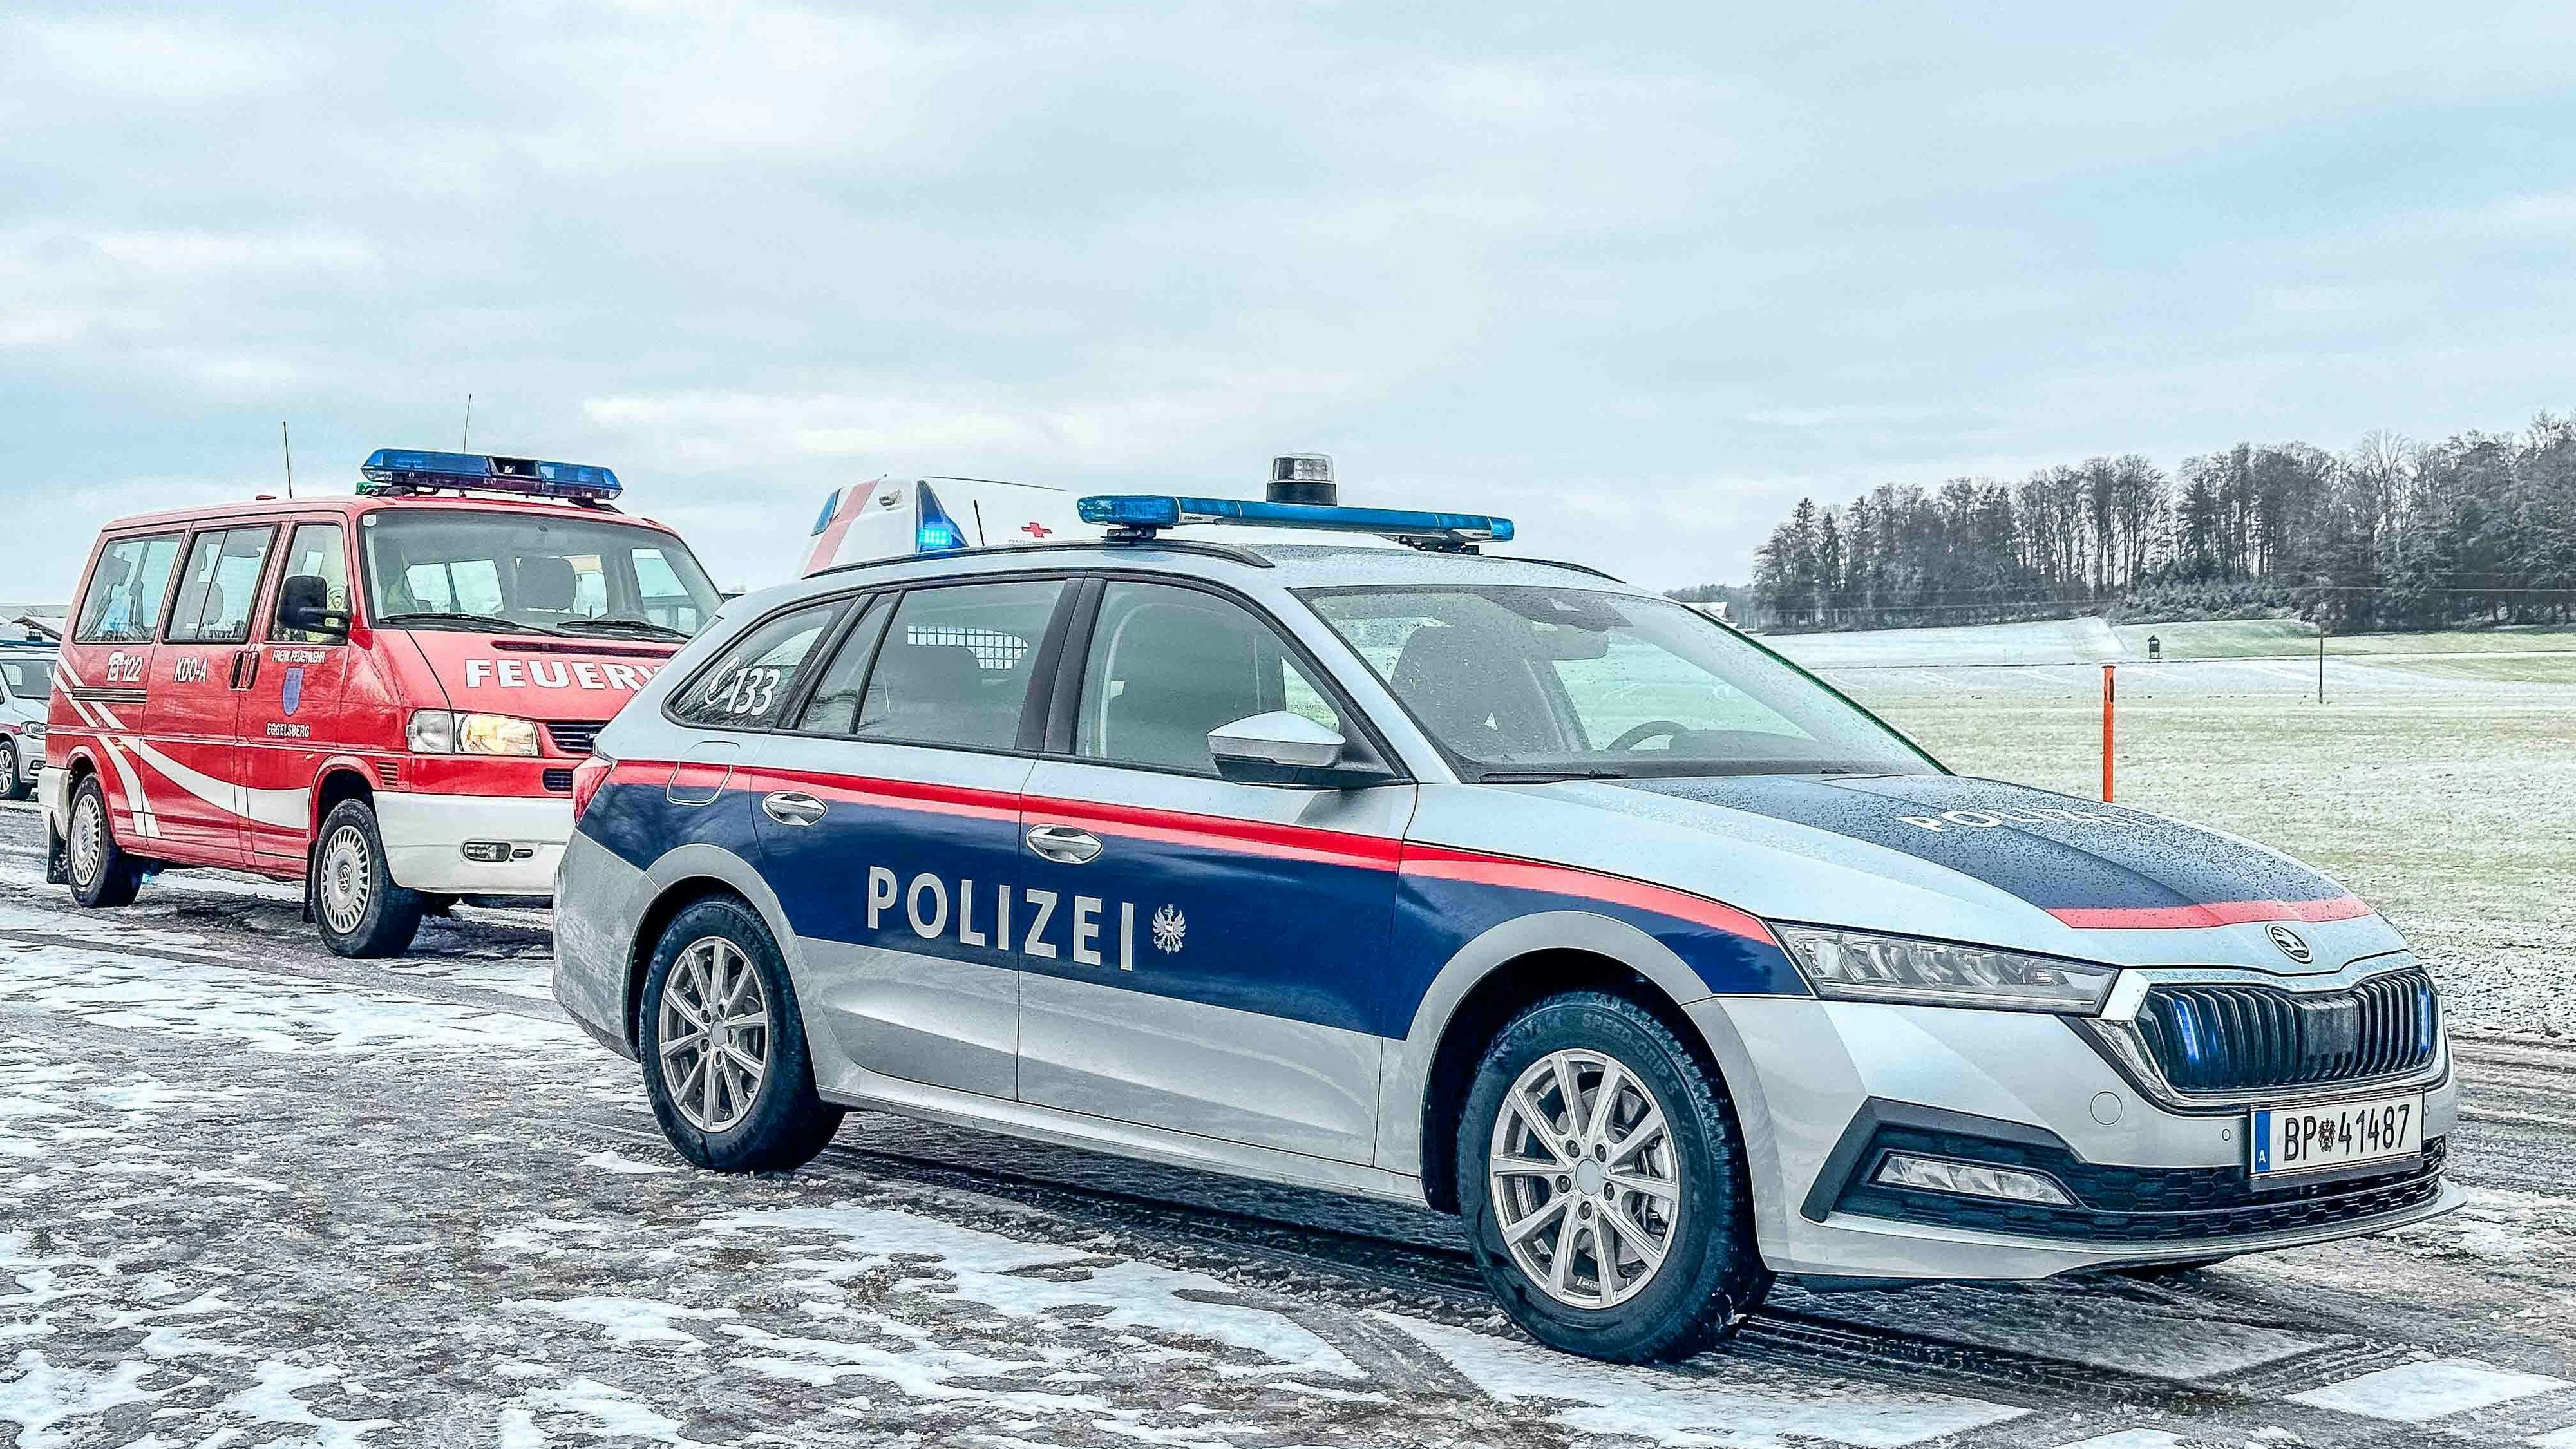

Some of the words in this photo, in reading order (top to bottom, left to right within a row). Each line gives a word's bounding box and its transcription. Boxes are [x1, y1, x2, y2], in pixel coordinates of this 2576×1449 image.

[122, 655, 144, 682] 122
[174, 656, 208, 683] KDO-A
[726, 667, 781, 715] 133
[266, 722, 310, 738] EGGELSBERG
[867, 866, 1135, 971] POLIZEI
[2284, 1115, 2317, 1161] BP
[2338, 1103, 2410, 1155] 41487
[2258, 1150, 2266, 1164] A
